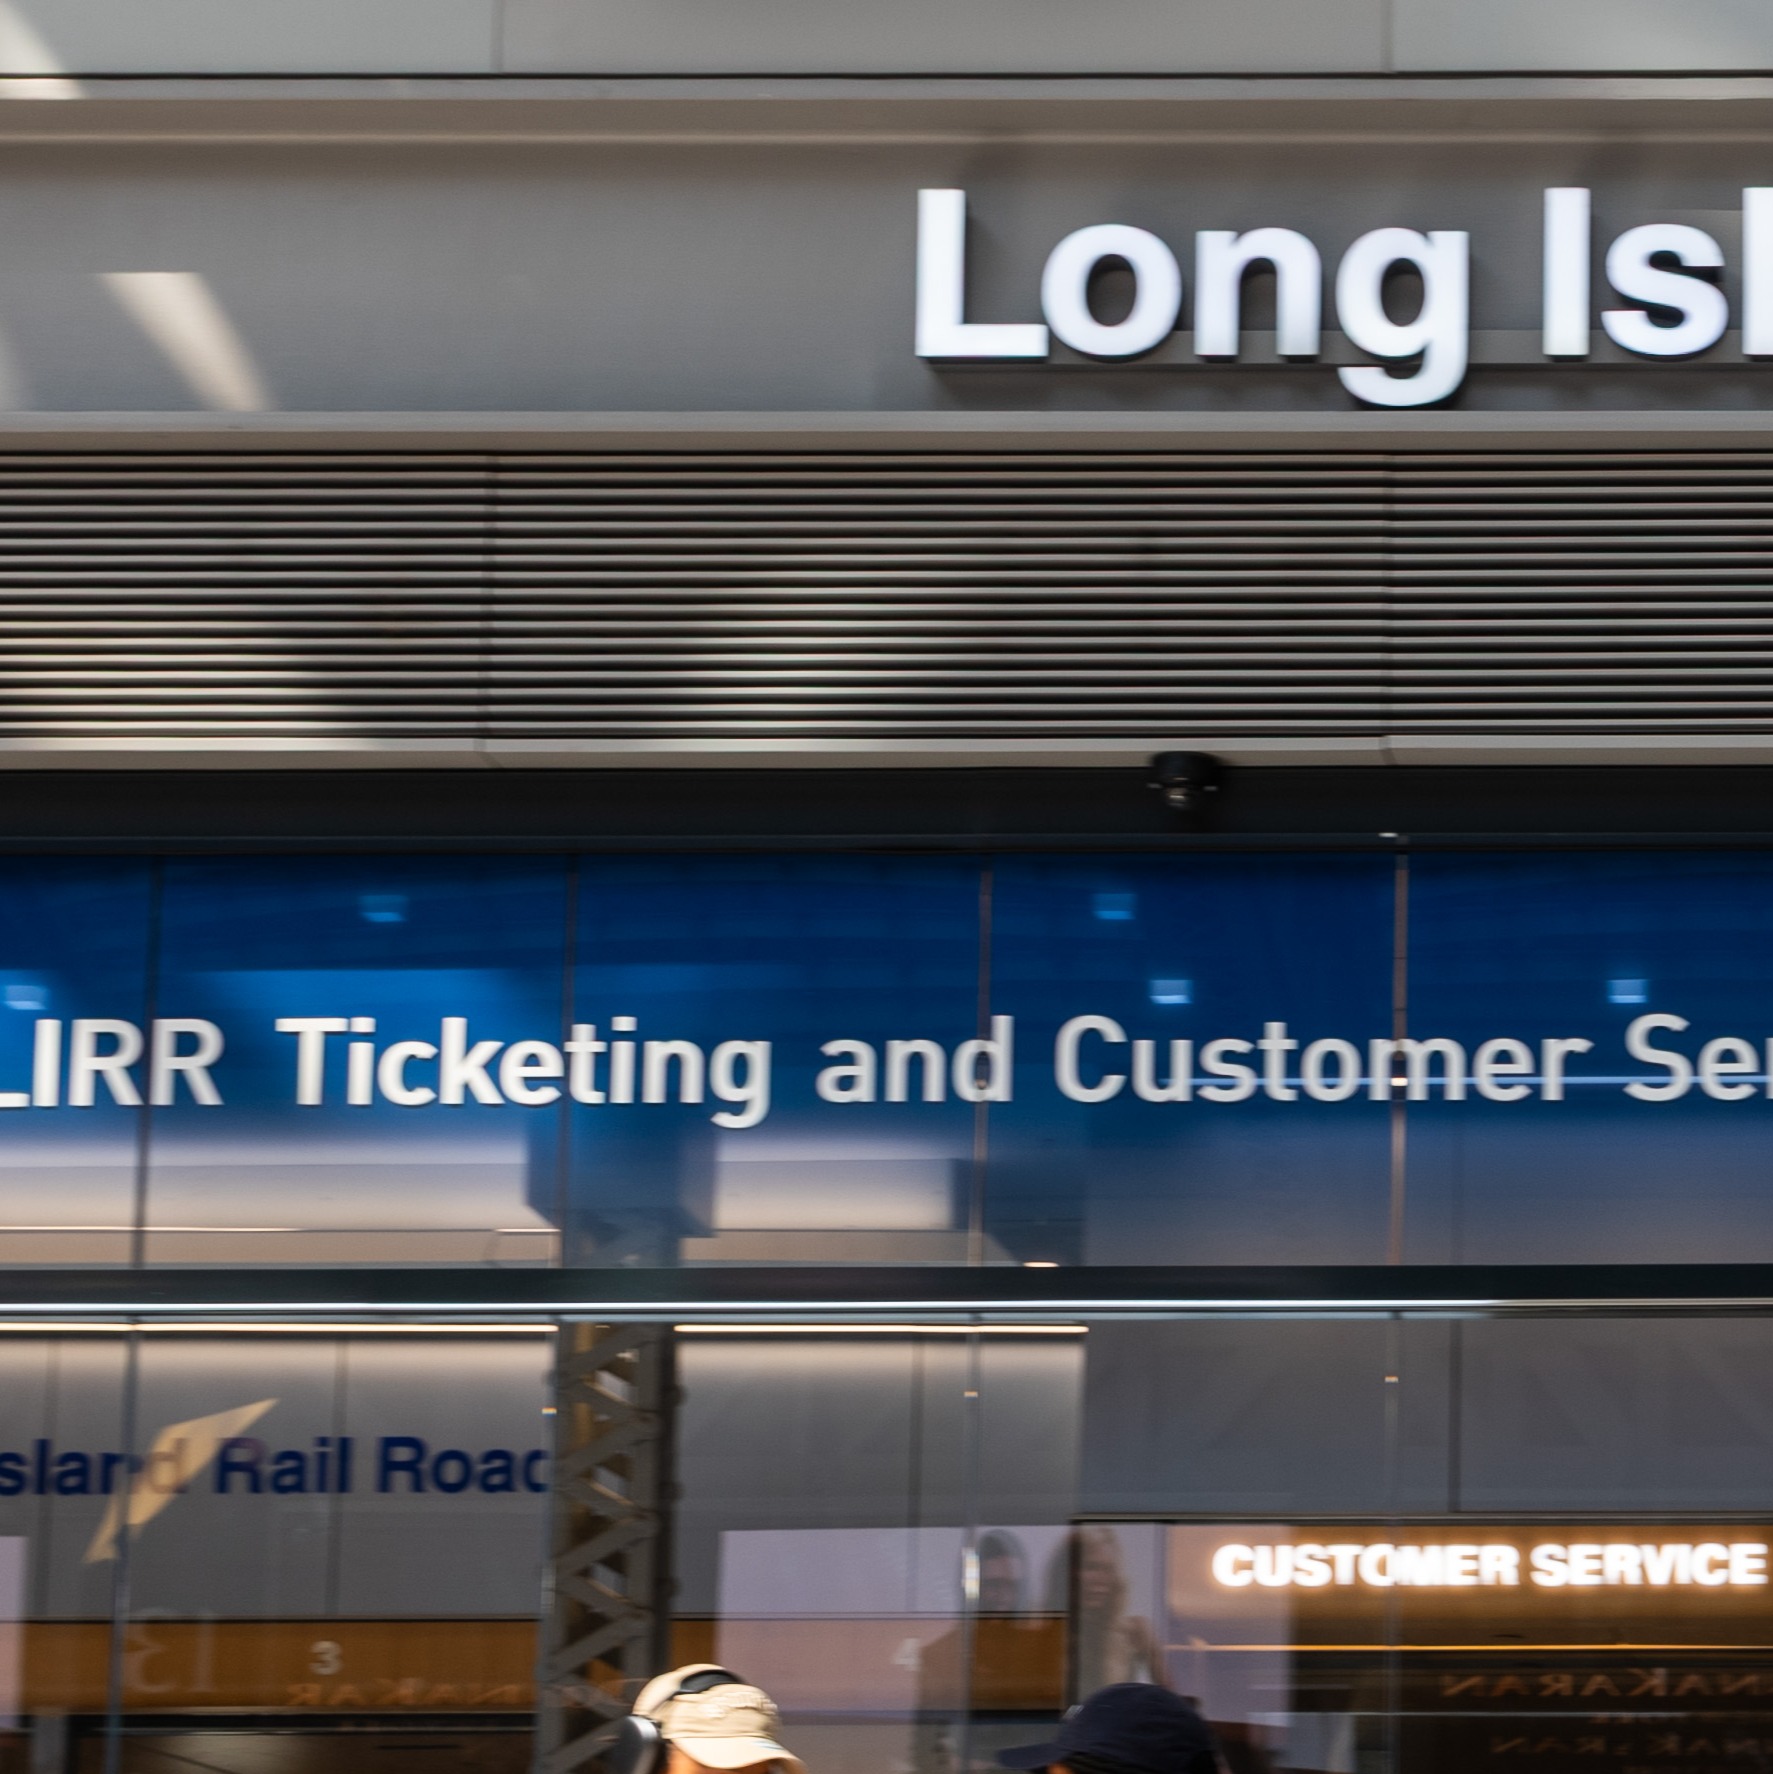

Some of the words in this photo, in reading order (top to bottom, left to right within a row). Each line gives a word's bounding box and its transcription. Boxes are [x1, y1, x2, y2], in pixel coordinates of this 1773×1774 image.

[915, 187, 1470, 407] Long
[275, 1015, 773, 1129] Ticketing
[815, 1014, 1016, 1105] and
[1053, 1013, 1595, 1104] Customer
[214, 1435, 352, 1494] Rail
[1211, 1543, 1521, 1589] CUSTOMER
[1529, 1542, 1770, 1587] SERVICE
[310, 1640, 343, 1676] 3
[891, 1637, 921, 1672] 4
